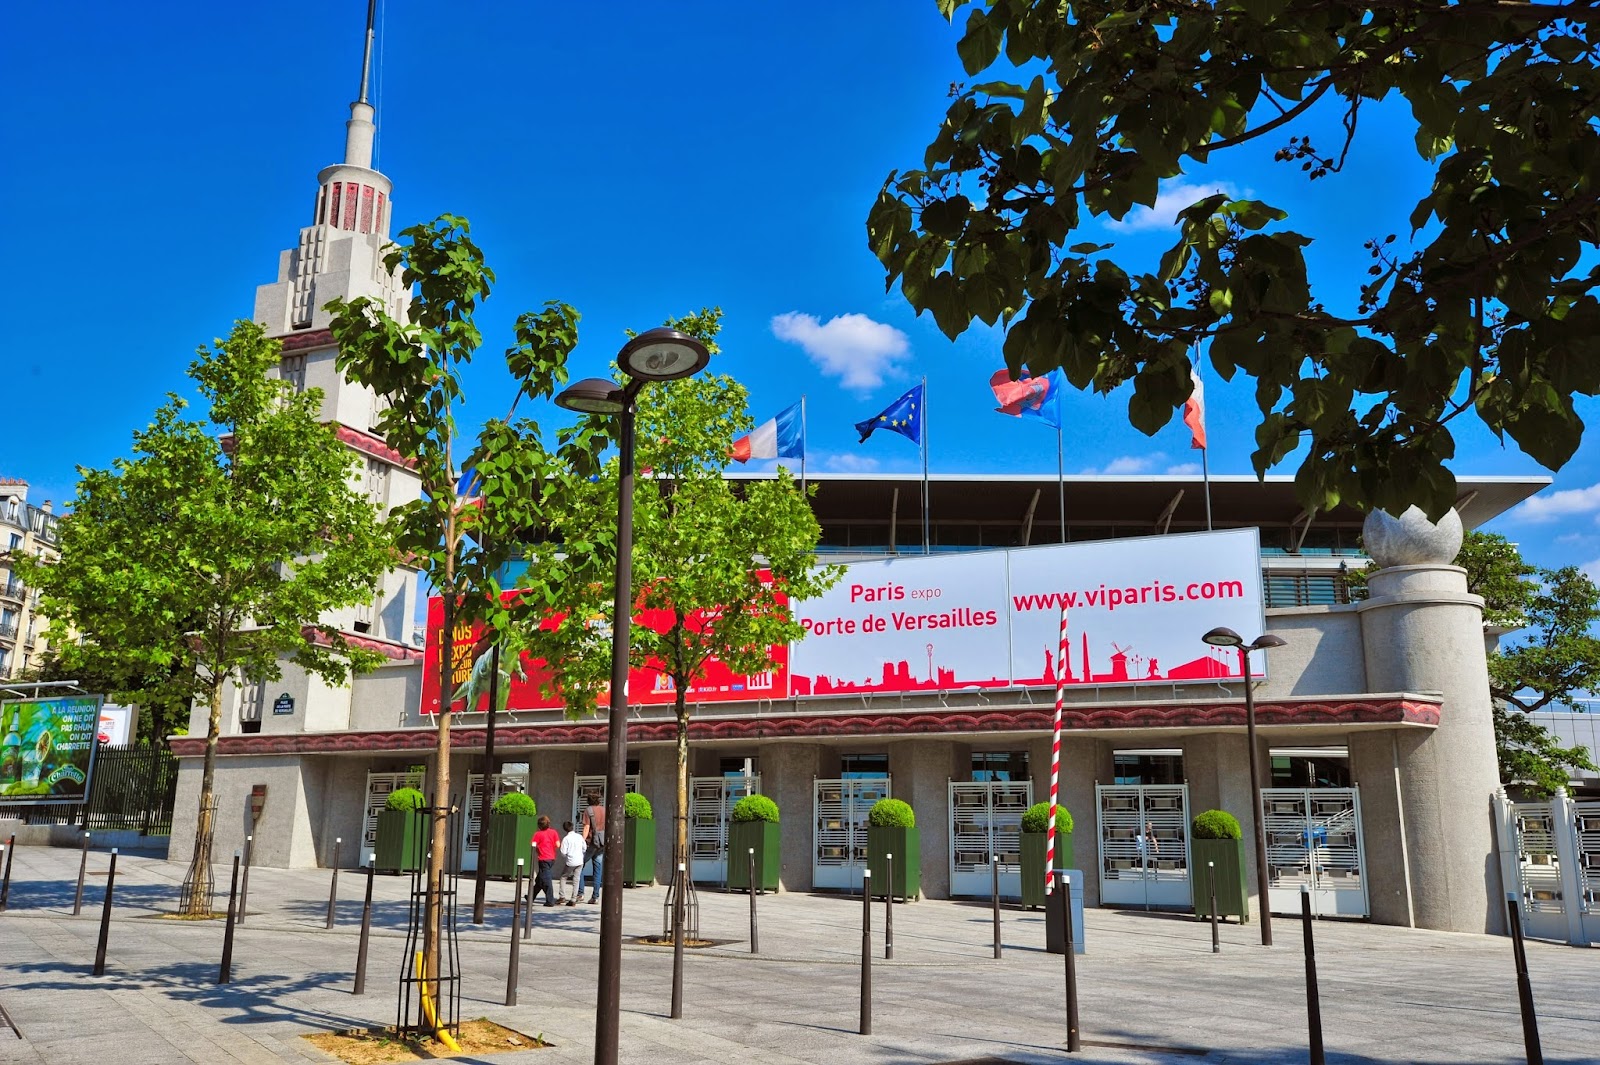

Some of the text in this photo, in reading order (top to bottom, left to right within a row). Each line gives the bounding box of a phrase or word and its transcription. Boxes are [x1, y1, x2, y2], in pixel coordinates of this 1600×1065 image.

[850, 582, 942, 603] Paris expo
[1012, 580, 1244, 612] www.viparis.com
[801, 608, 997, 636] Porte de Versailles
[438, 624, 473, 645] DNOS
[74, 714, 83, 722] NE
[61, 723, 94, 732] PAS RHUM
[69, 733, 80, 741] ON
[56, 742, 90, 750] CHARRETTE
